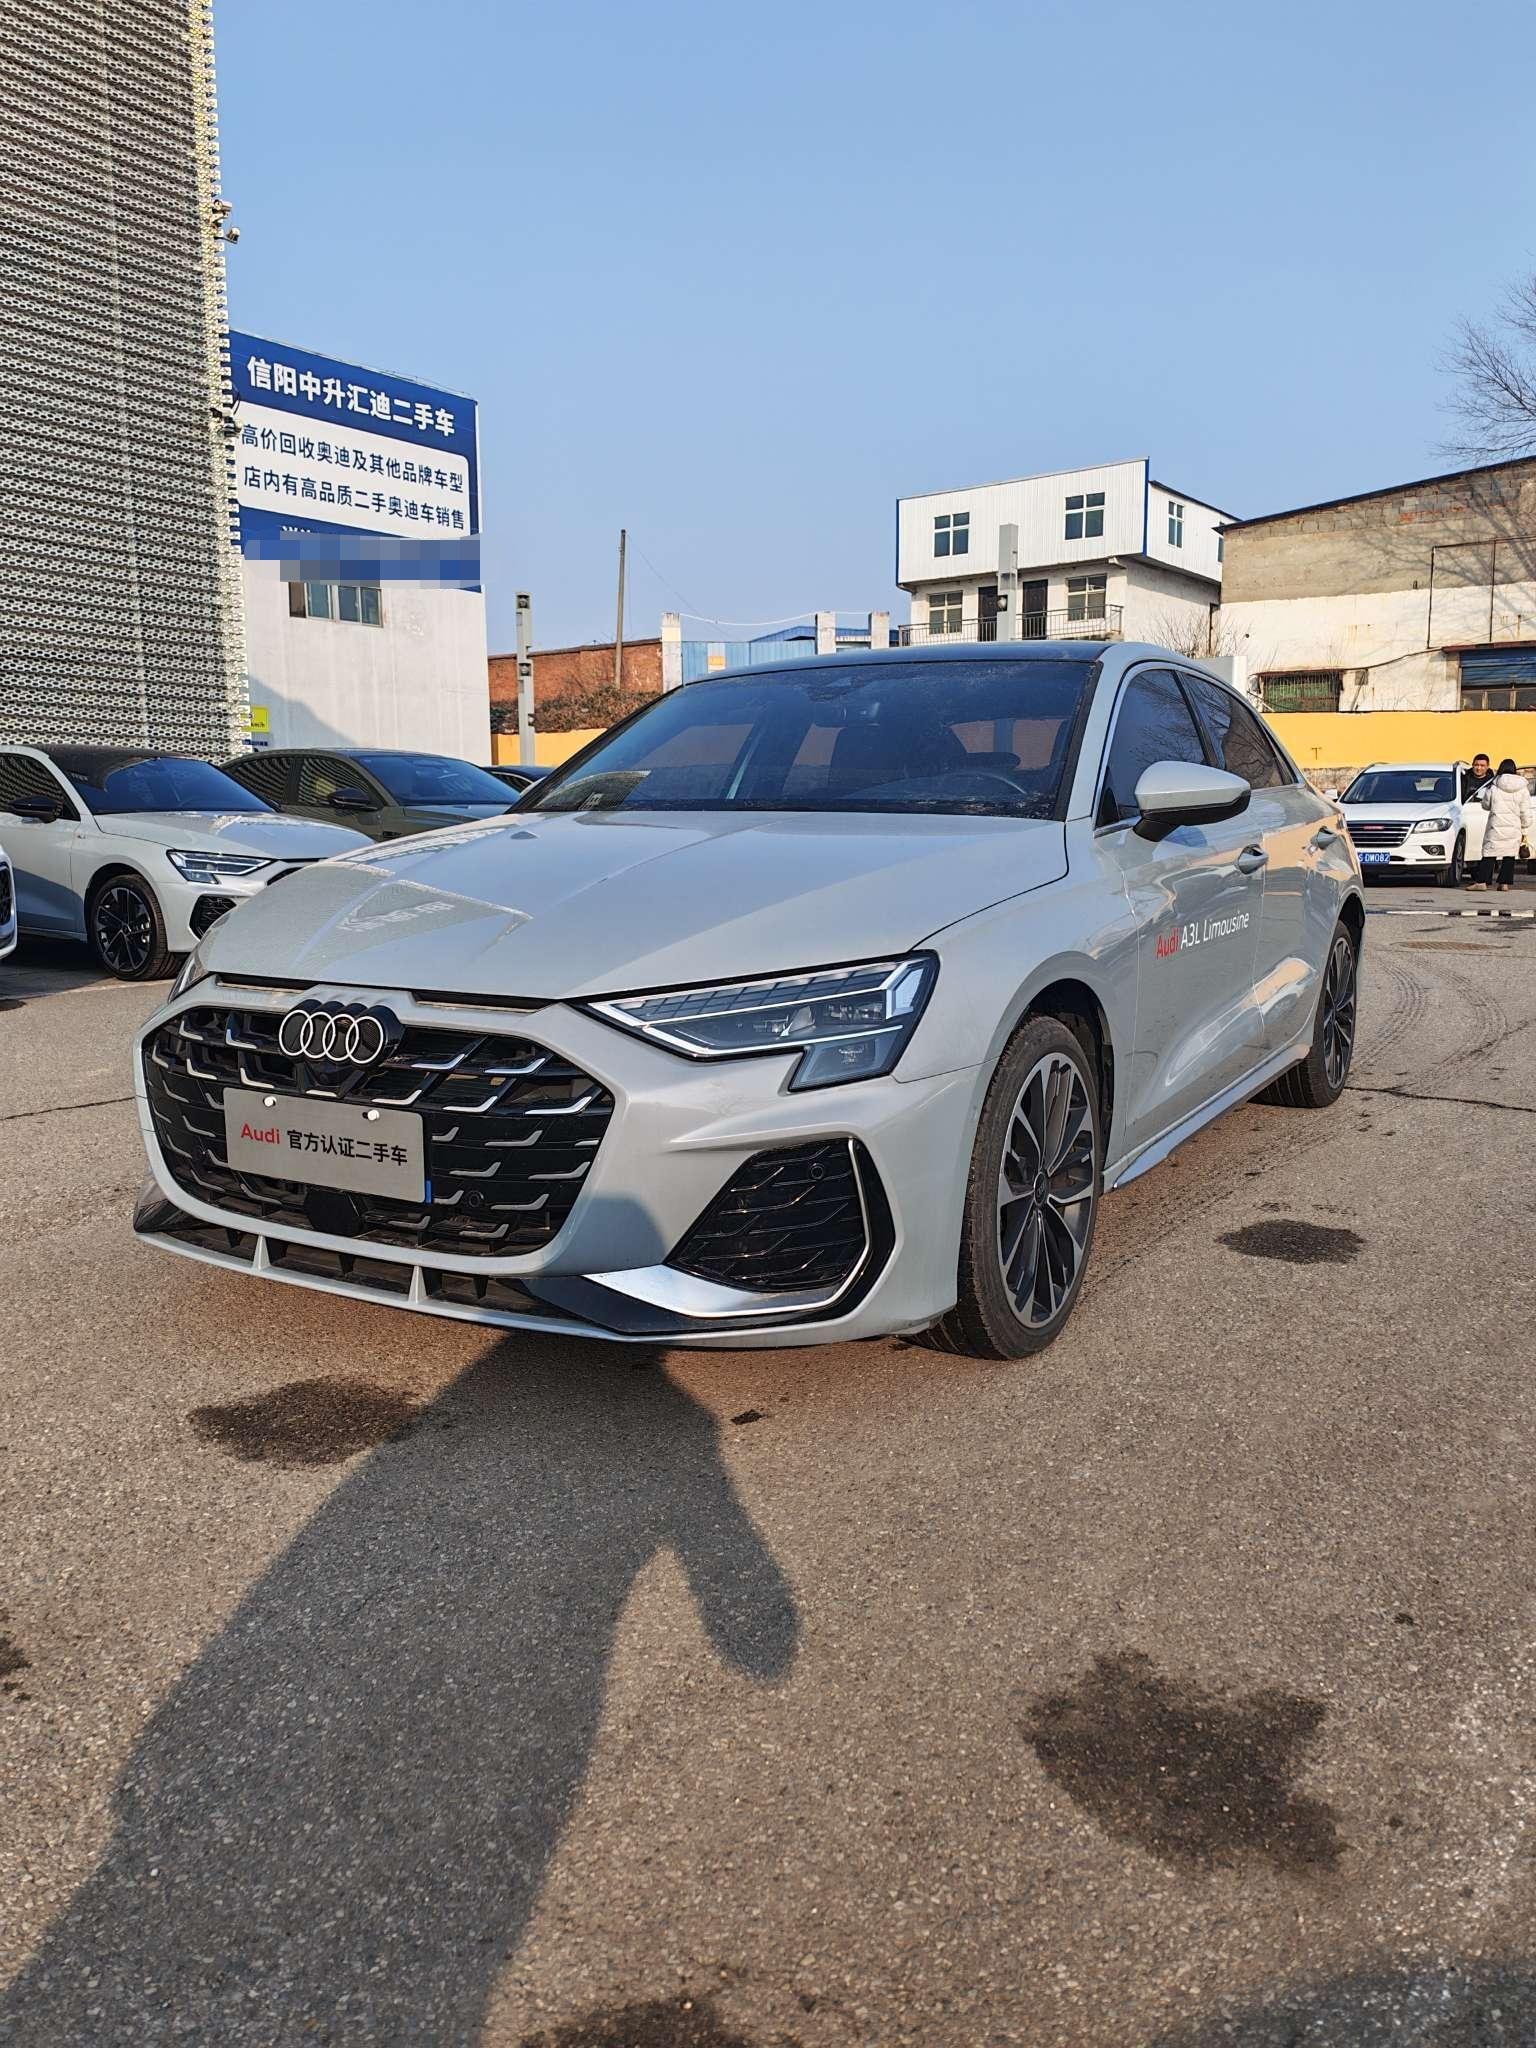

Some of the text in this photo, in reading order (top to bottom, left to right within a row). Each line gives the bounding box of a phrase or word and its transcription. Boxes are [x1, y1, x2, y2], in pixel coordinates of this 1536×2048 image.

[246, 355, 455, 437] 信阳中升汇迪二手车
[241, 424, 463, 493] 高价回收奥迪及其他品牌车型
[244, 466, 464, 530] 店内有高品质二手奥迪车销售
[1156, 911, 1250, 959] Audi A3L Limousine
[240, 1122, 407, 1166] Audi 官方认证二手车
